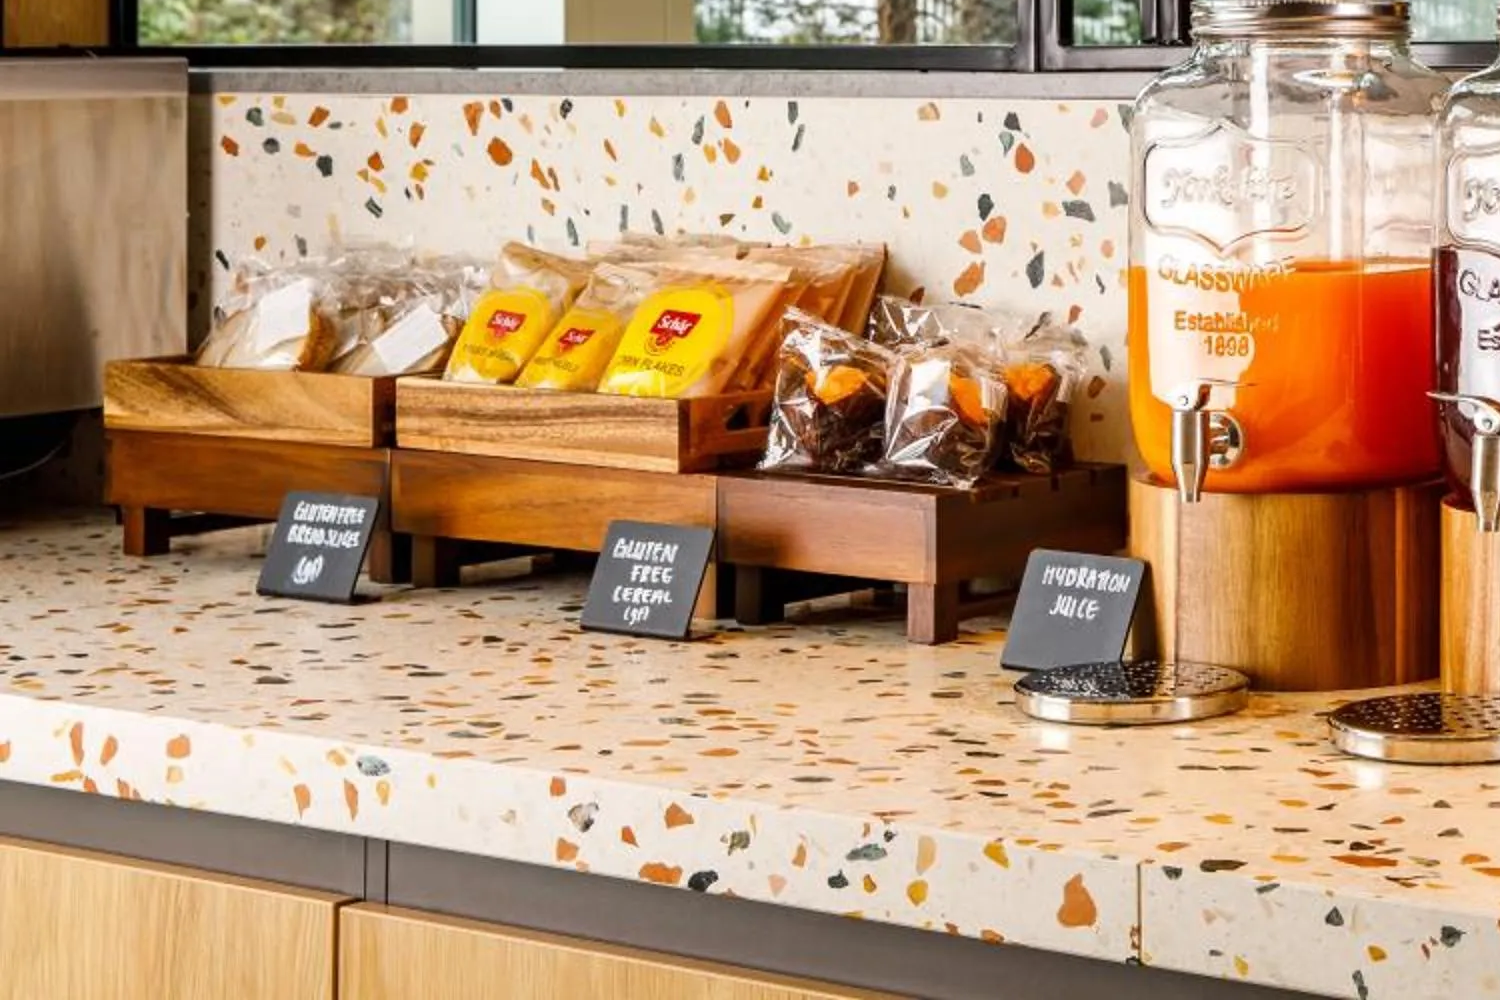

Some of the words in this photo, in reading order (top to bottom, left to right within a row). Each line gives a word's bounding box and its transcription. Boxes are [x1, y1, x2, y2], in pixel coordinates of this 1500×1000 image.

[612, 537, 679, 563] GLUTEN
[630, 564, 674, 584] FREE
[1042, 564, 1131, 593] HYDRATION
[612, 585, 673, 605] CEREAL
[1048, 593, 1100, 621] JUICE
